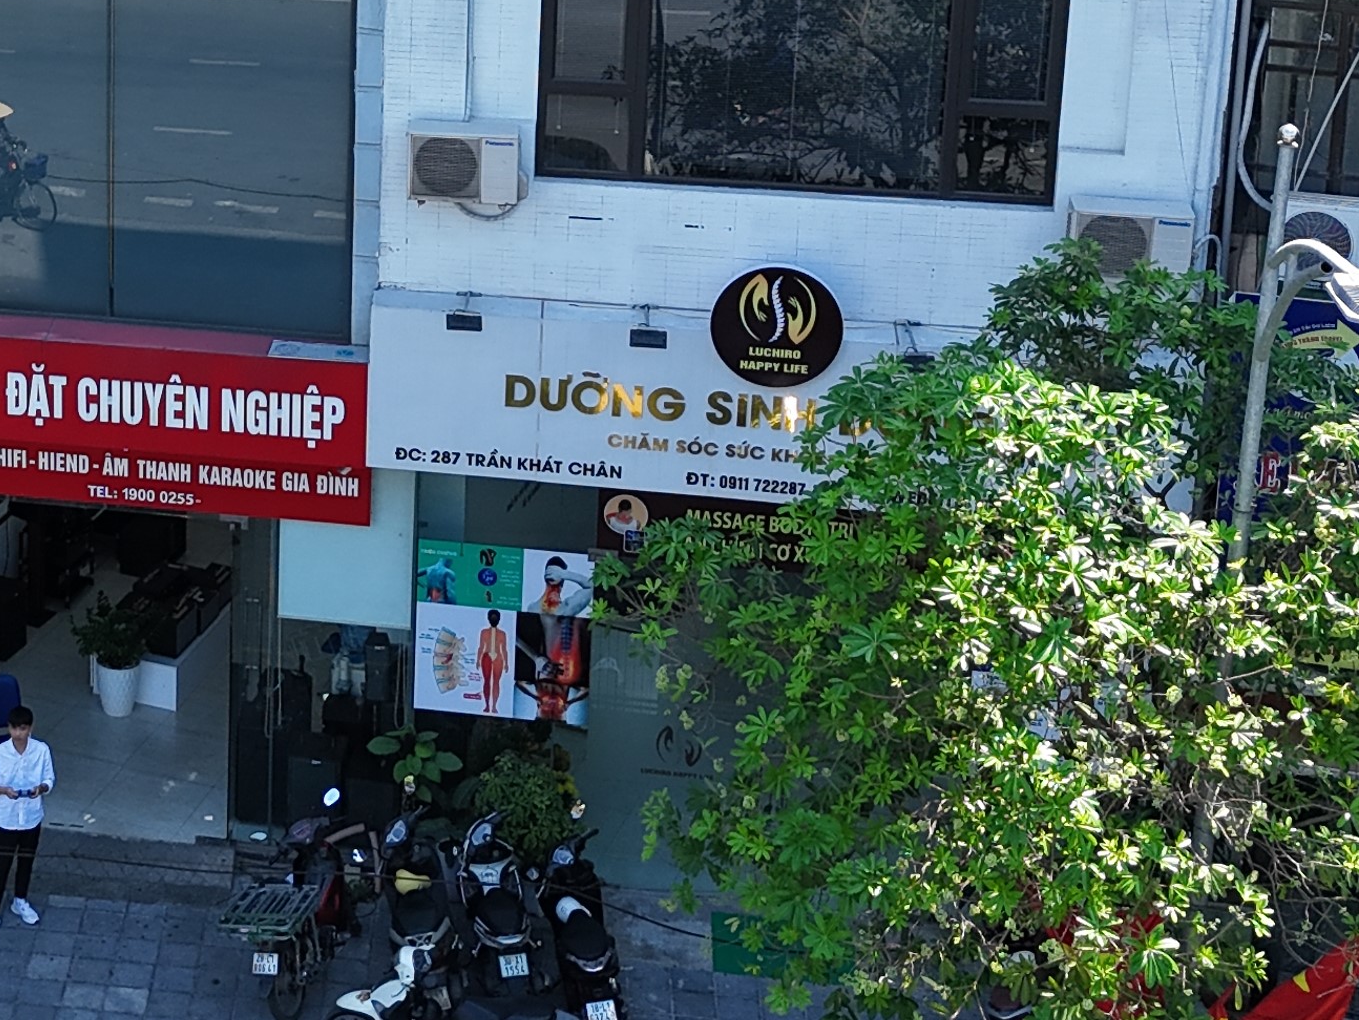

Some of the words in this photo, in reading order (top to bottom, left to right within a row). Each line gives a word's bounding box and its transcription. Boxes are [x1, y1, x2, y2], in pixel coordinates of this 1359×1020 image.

[749, 346, 801, 360] LUCHIRO
[740, 360, 781, 373] HAPPY
[783, 362, 809, 375] LIFE
[6, 363, 67, 427] ĐẶT
[77, 373, 209, 431] CHUYÊN
[221, 384, 345, 449] NGHIỆP
[504, 371, 686, 422] DƯỠNG
[608, 432, 668, 454] CHĂM
[676, 435, 718, 457] SÓC
[726, 437, 765, 460] SỨC
[38, 452, 89, 476] HIEND
[102, 452, 129, 478] ÂM
[136, 460, 191, 484] THANH
[198, 465, 276, 491] KARAOKE
[281, 471, 310, 494] GIA
[316, 468, 359, 498] ĐÌNH
[395, 447, 427, 464] ĐC:
[431, 450, 461, 466] 287
[517, 454, 563, 475] KHÁT
[568, 457, 623, 480] CHÂN
[88, 484, 118, 500] TEL:
[122, 487, 155, 502] 1900
[686, 471, 715, 488] ĐT:
[719, 475, 749, 491] 0911
[753, 478, 806, 497] 722287
